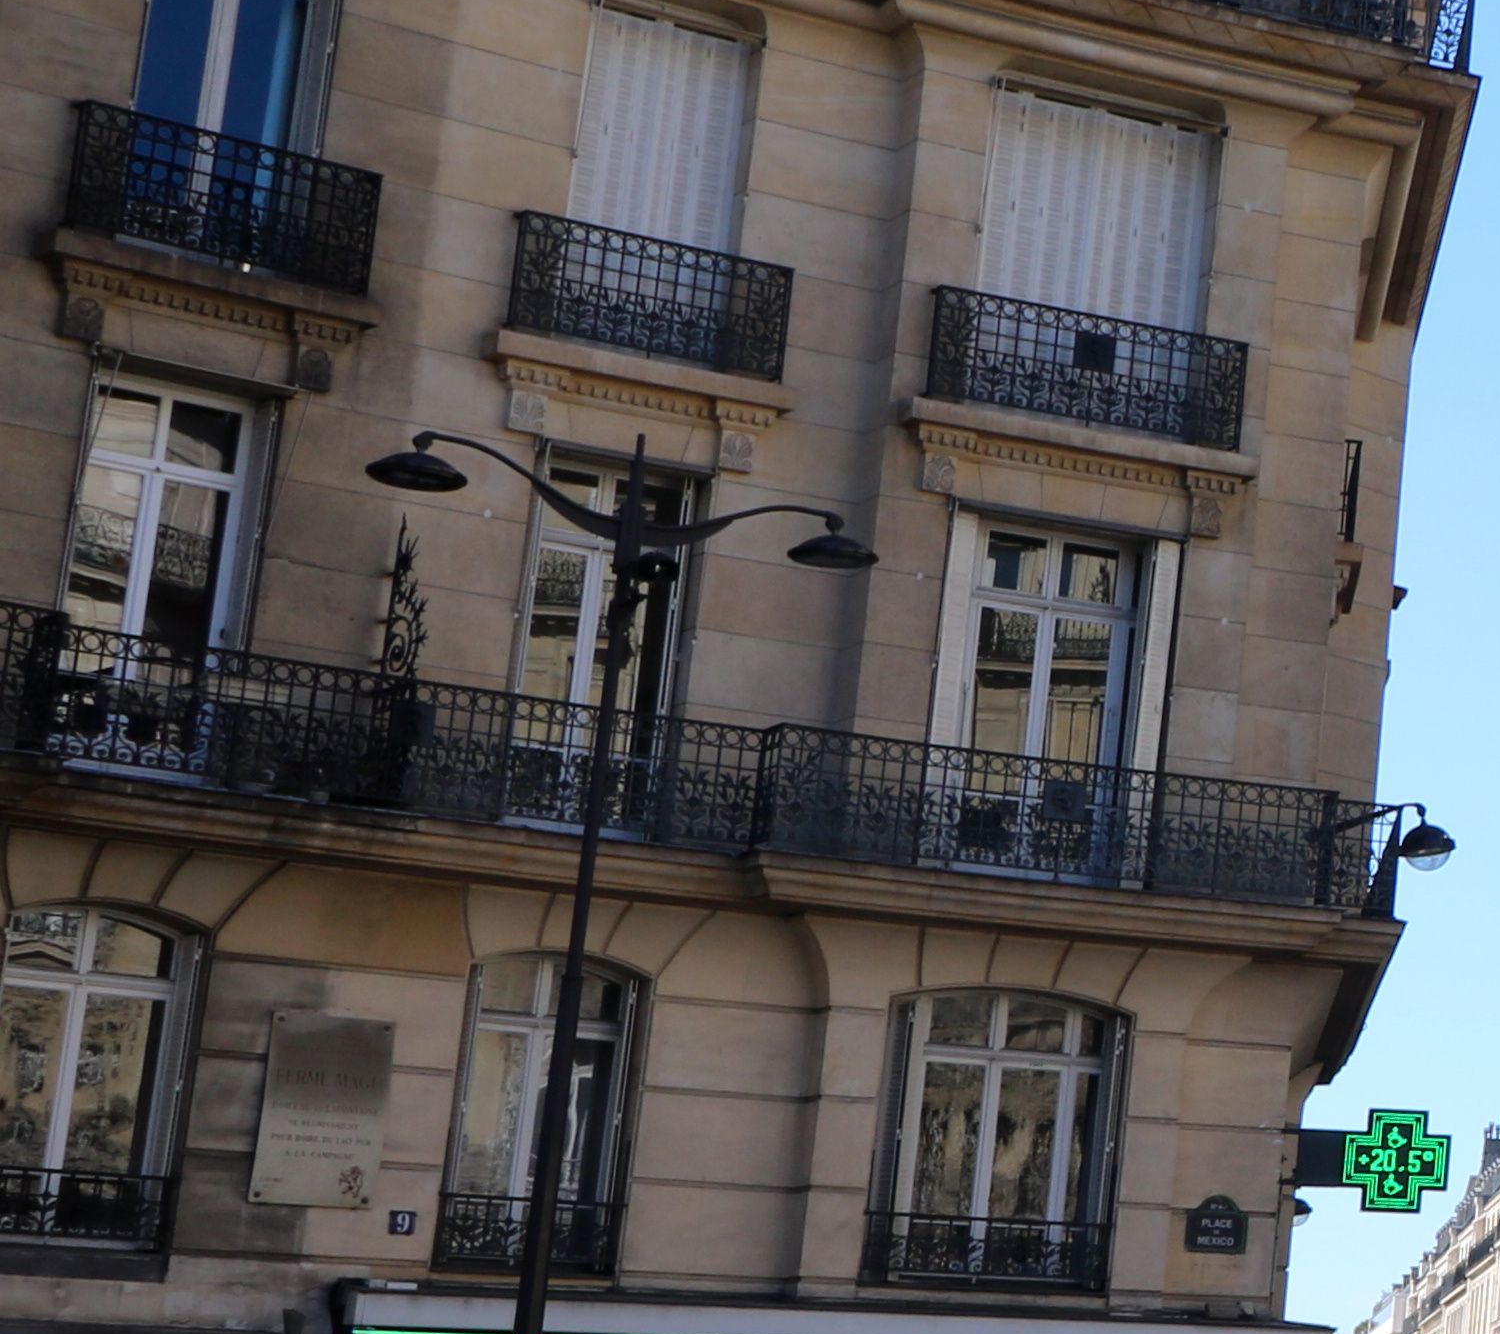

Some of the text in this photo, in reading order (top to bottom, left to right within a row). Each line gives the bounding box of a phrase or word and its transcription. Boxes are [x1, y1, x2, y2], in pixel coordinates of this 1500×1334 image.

[396, 1212, 410, 1234] 9
[1200, 1218, 1233, 1229] PLACE
[1196, 1236, 1235, 1247] MEXICO
